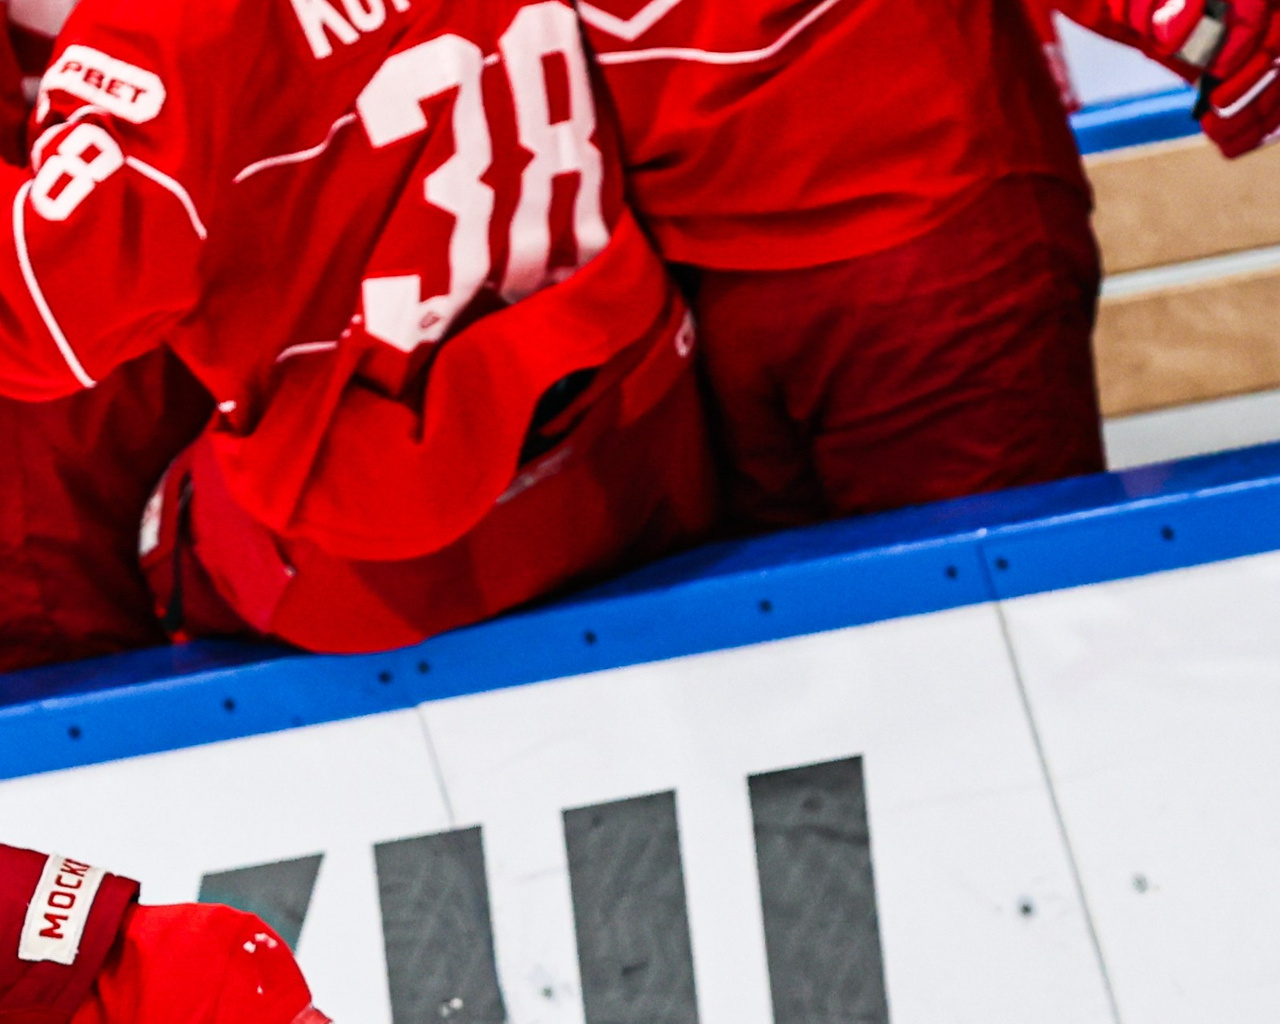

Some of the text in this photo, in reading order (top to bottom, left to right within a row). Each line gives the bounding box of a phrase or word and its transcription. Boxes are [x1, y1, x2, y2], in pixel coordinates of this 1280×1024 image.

[30, 122, 125, 222] 8
[356, 0, 611, 353] 38
[38, 857, 92, 940] МОСК
